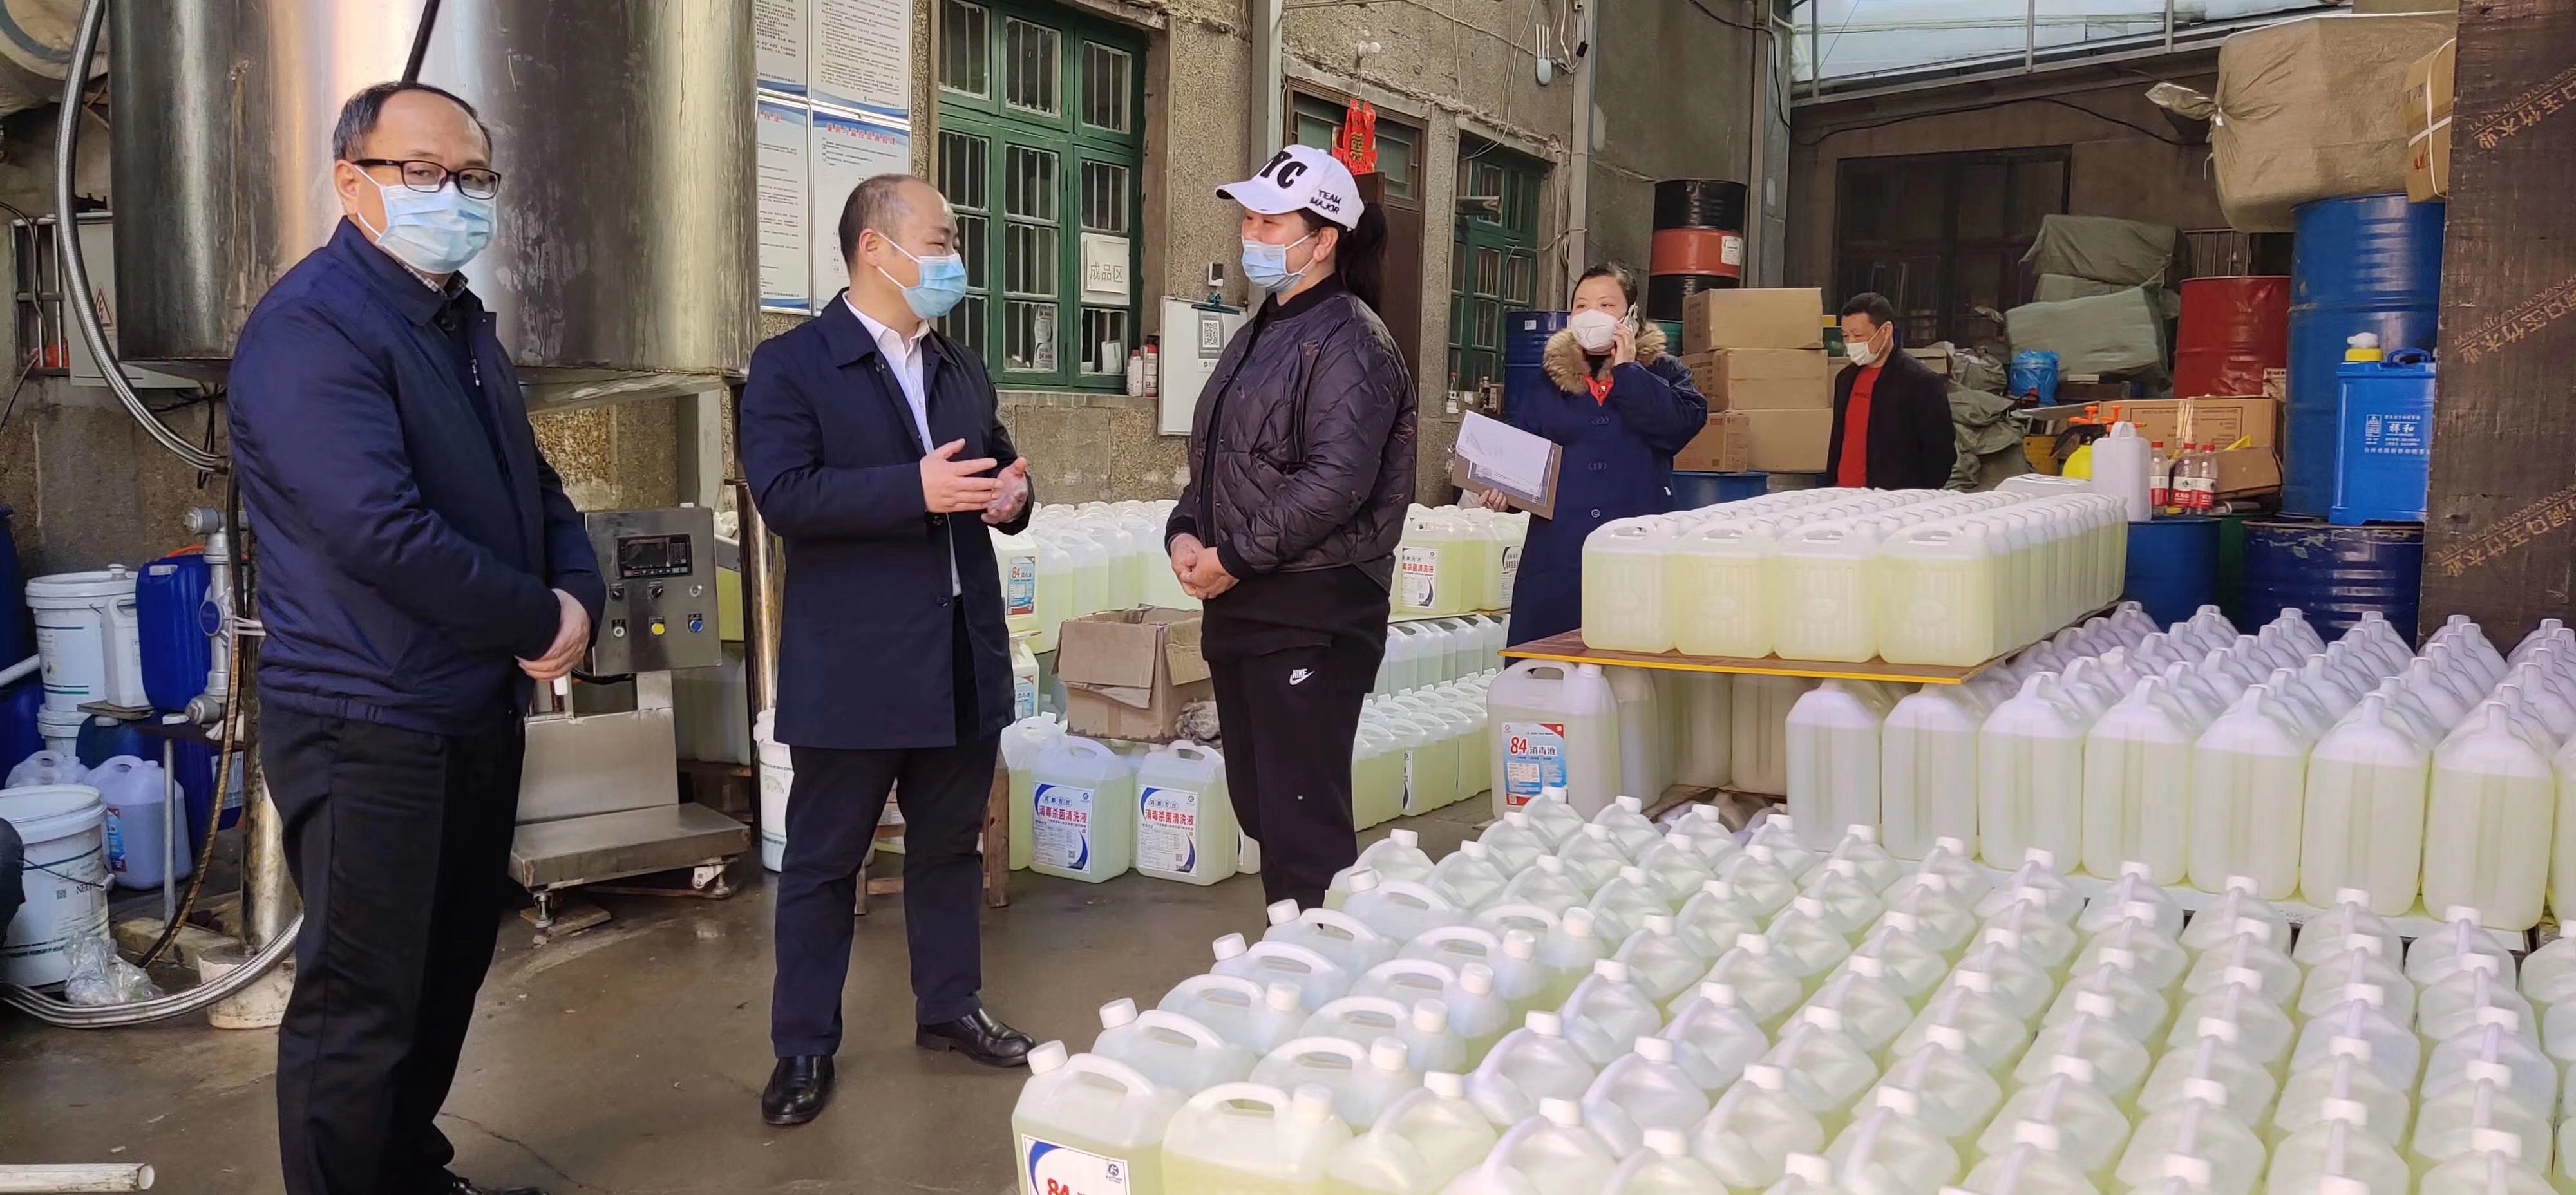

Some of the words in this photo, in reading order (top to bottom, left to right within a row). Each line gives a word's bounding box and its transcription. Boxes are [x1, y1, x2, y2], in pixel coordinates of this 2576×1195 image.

[1309, 197, 1340, 214] MAJOR
[1318, 189, 1341, 205] TEAM
[1090, 261, 1123, 283] 成品区
[2441, 498, 2576, 577] 洞口玉竹木业
[1293, 669, 1307, 679] NIKE
[1510, 737, 1527, 754] 84
[1039, 805, 1088, 823] 消毒杀菌清洗液
[1145, 809, 1195, 826] 消毒杀菌清洗液
